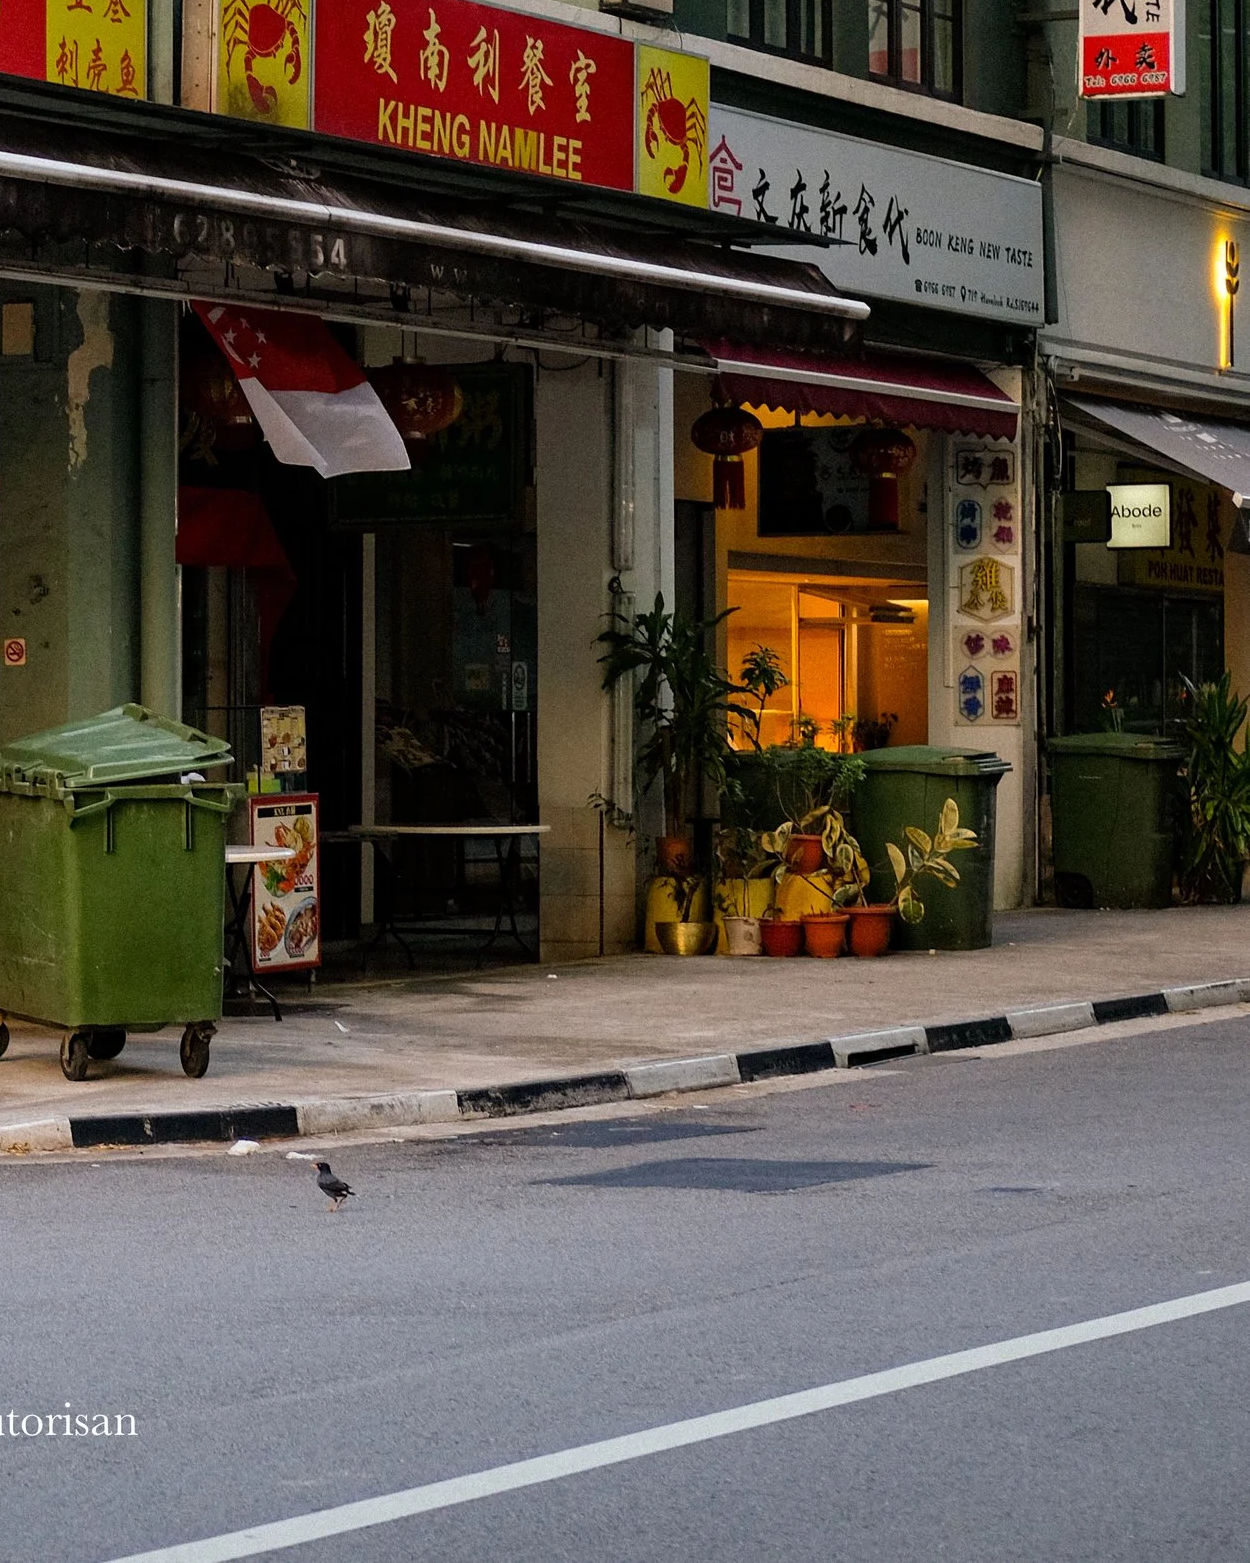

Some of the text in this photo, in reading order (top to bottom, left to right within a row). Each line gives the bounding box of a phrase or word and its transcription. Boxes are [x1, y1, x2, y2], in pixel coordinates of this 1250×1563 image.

[363, 0, 597, 125] 瓊南利餐室
[378, 98, 471, 157] KHENG
[751, 168, 910, 265] 文庆新食代
[915, 227, 1032, 268] BOON KENG NEW TASTE
[1111, 504, 1162, 519] Abode
[1170, 563, 1194, 583] HUAT
